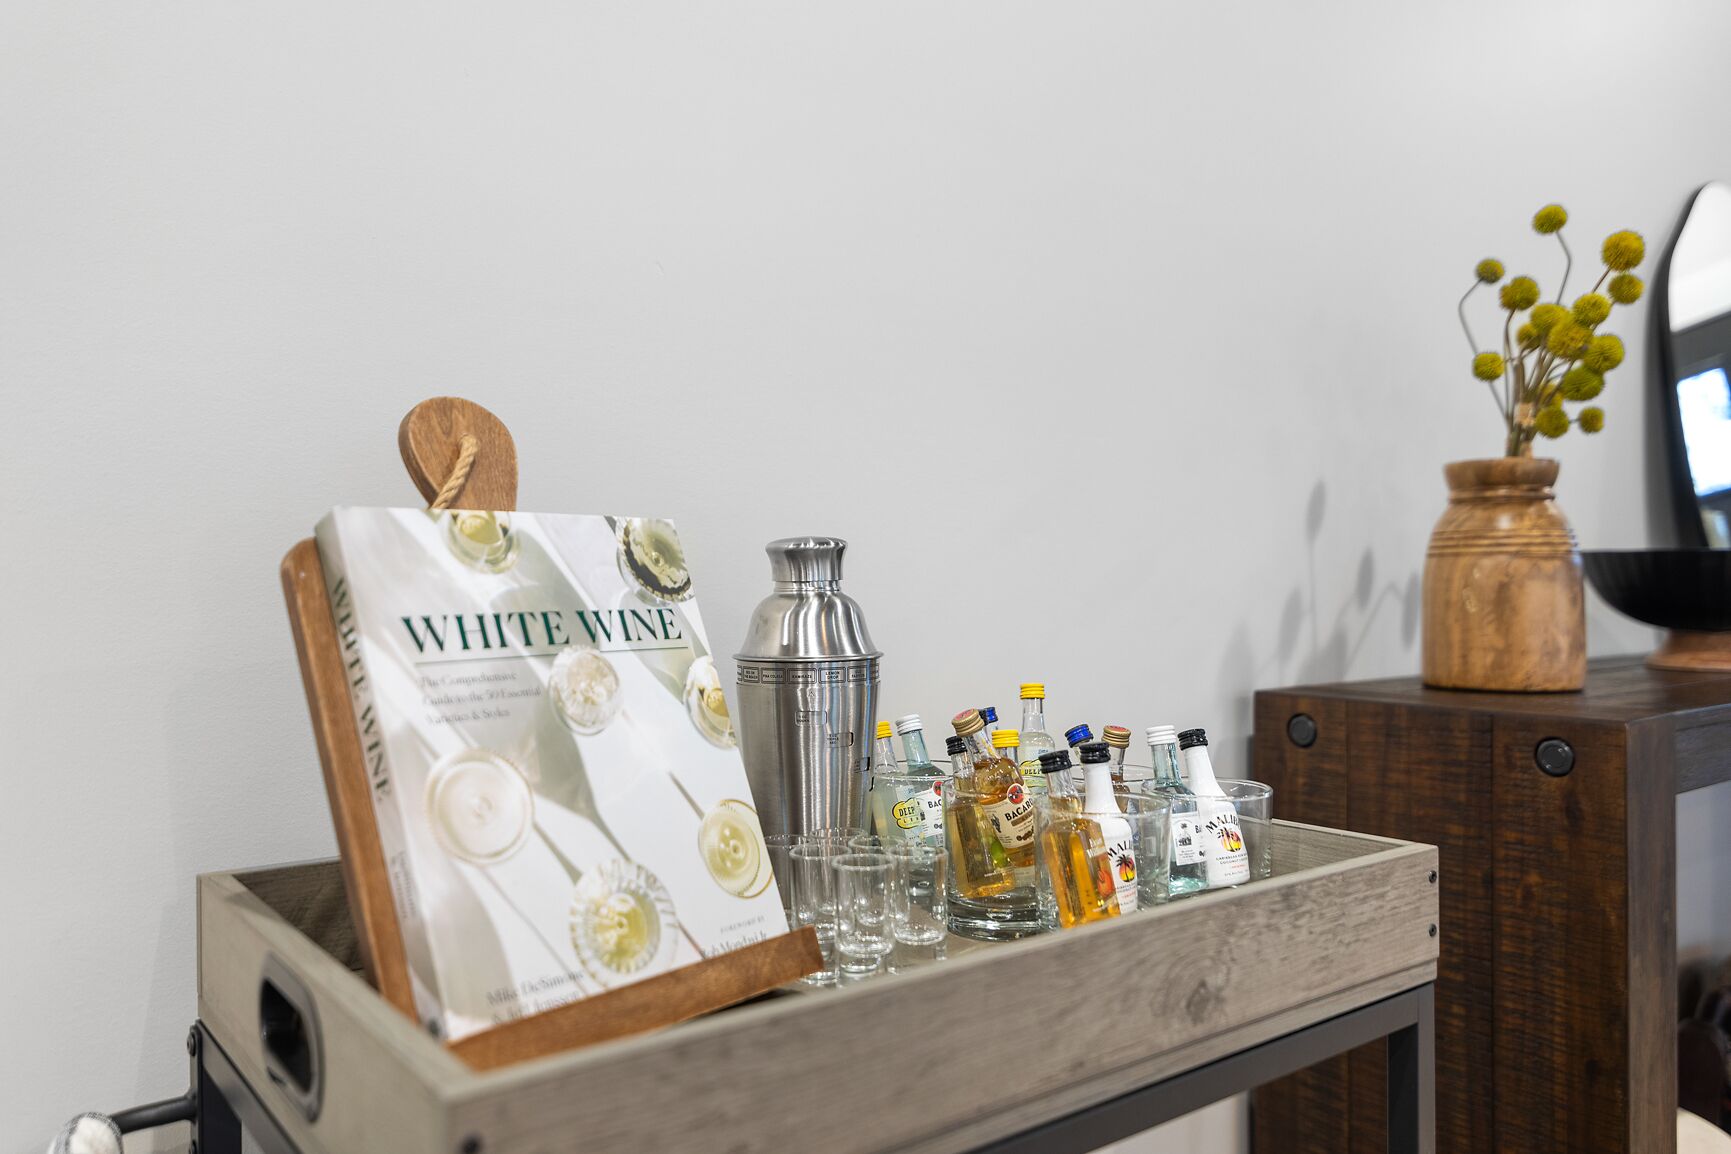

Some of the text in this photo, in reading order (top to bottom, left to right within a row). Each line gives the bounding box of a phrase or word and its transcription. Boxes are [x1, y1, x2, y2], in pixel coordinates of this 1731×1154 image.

[401, 607, 682, 654] WHITE WINE
[333, 577, 391, 803] WHITE WINE
[898, 806, 915, 817] DEEP
